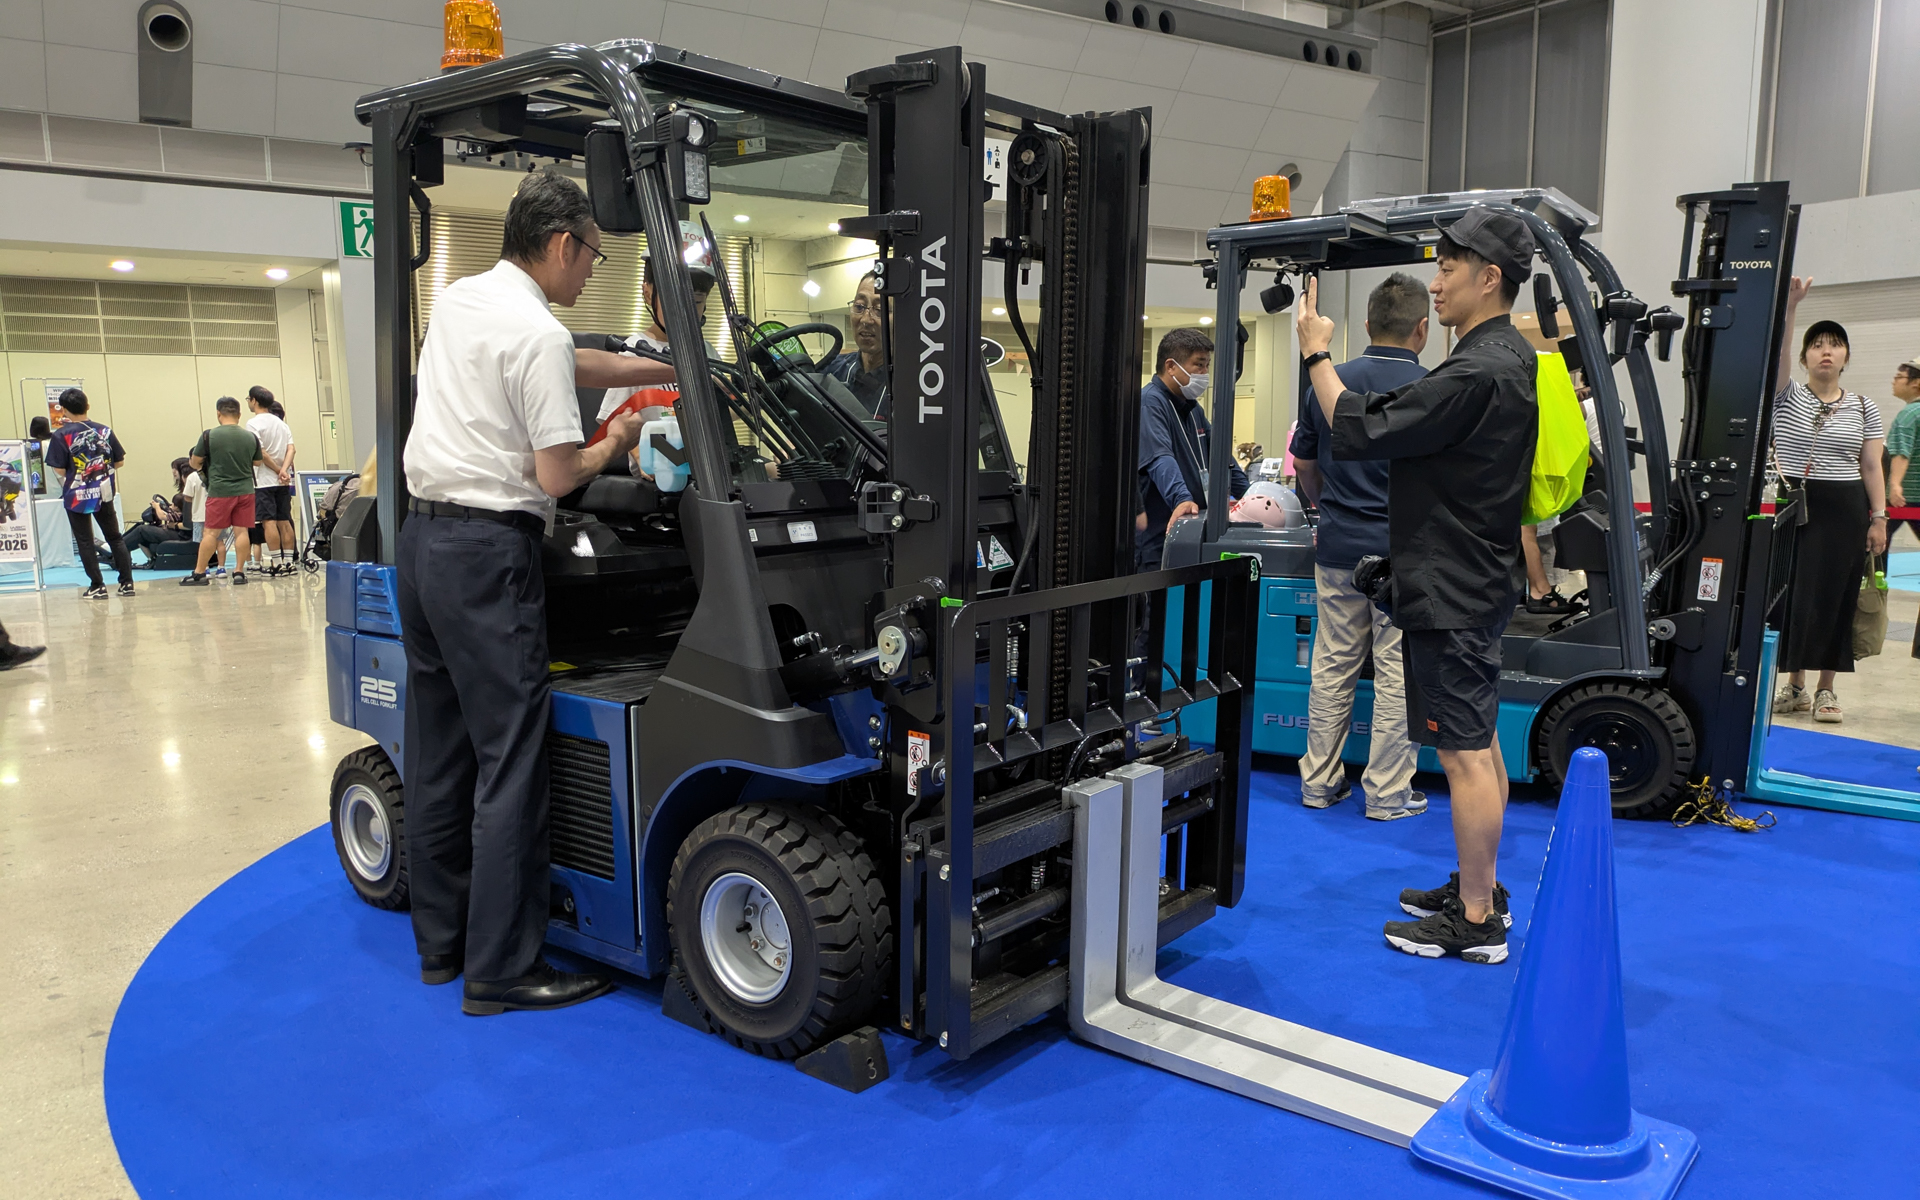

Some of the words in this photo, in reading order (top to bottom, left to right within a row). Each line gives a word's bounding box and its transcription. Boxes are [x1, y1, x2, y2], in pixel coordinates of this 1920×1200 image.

[683, 232, 703, 241] TOY
[1730, 260, 1772, 269] TOYOTA
[919, 236, 947, 423] TOYOTA
[0, 539, 28, 551] 2026
[360, 675, 397, 703] 25
[361, 696, 370, 704] FUEL
[370, 698, 380, 706] CELL
[380, 701, 398, 710] FORKLIFT
[1263, 713, 1309, 730] FUE
